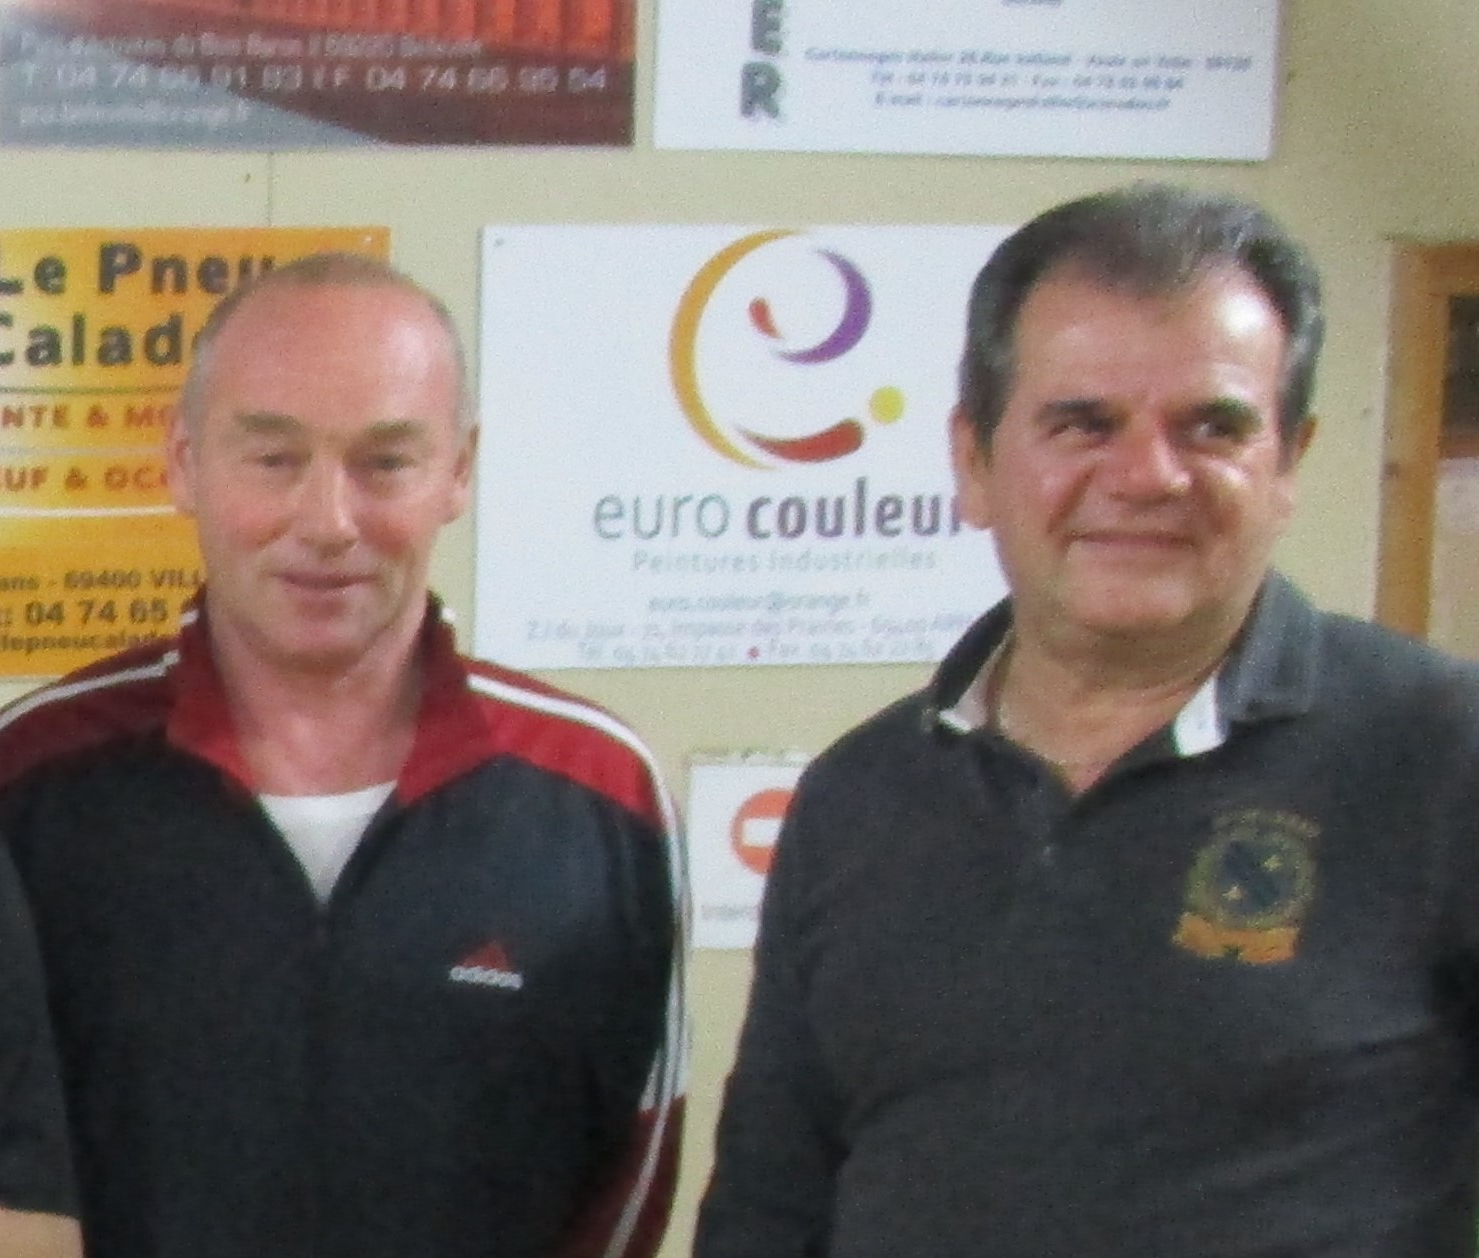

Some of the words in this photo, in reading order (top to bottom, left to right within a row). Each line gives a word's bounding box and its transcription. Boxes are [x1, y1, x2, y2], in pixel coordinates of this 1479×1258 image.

[85, 403, 110, 429] &
[63, 465, 89, 492] &
[593, 493, 732, 541] euro
[632, 549, 757, 573] Peintures
[24, 600, 65, 627] 04
[78, 599, 119, 626] 74
